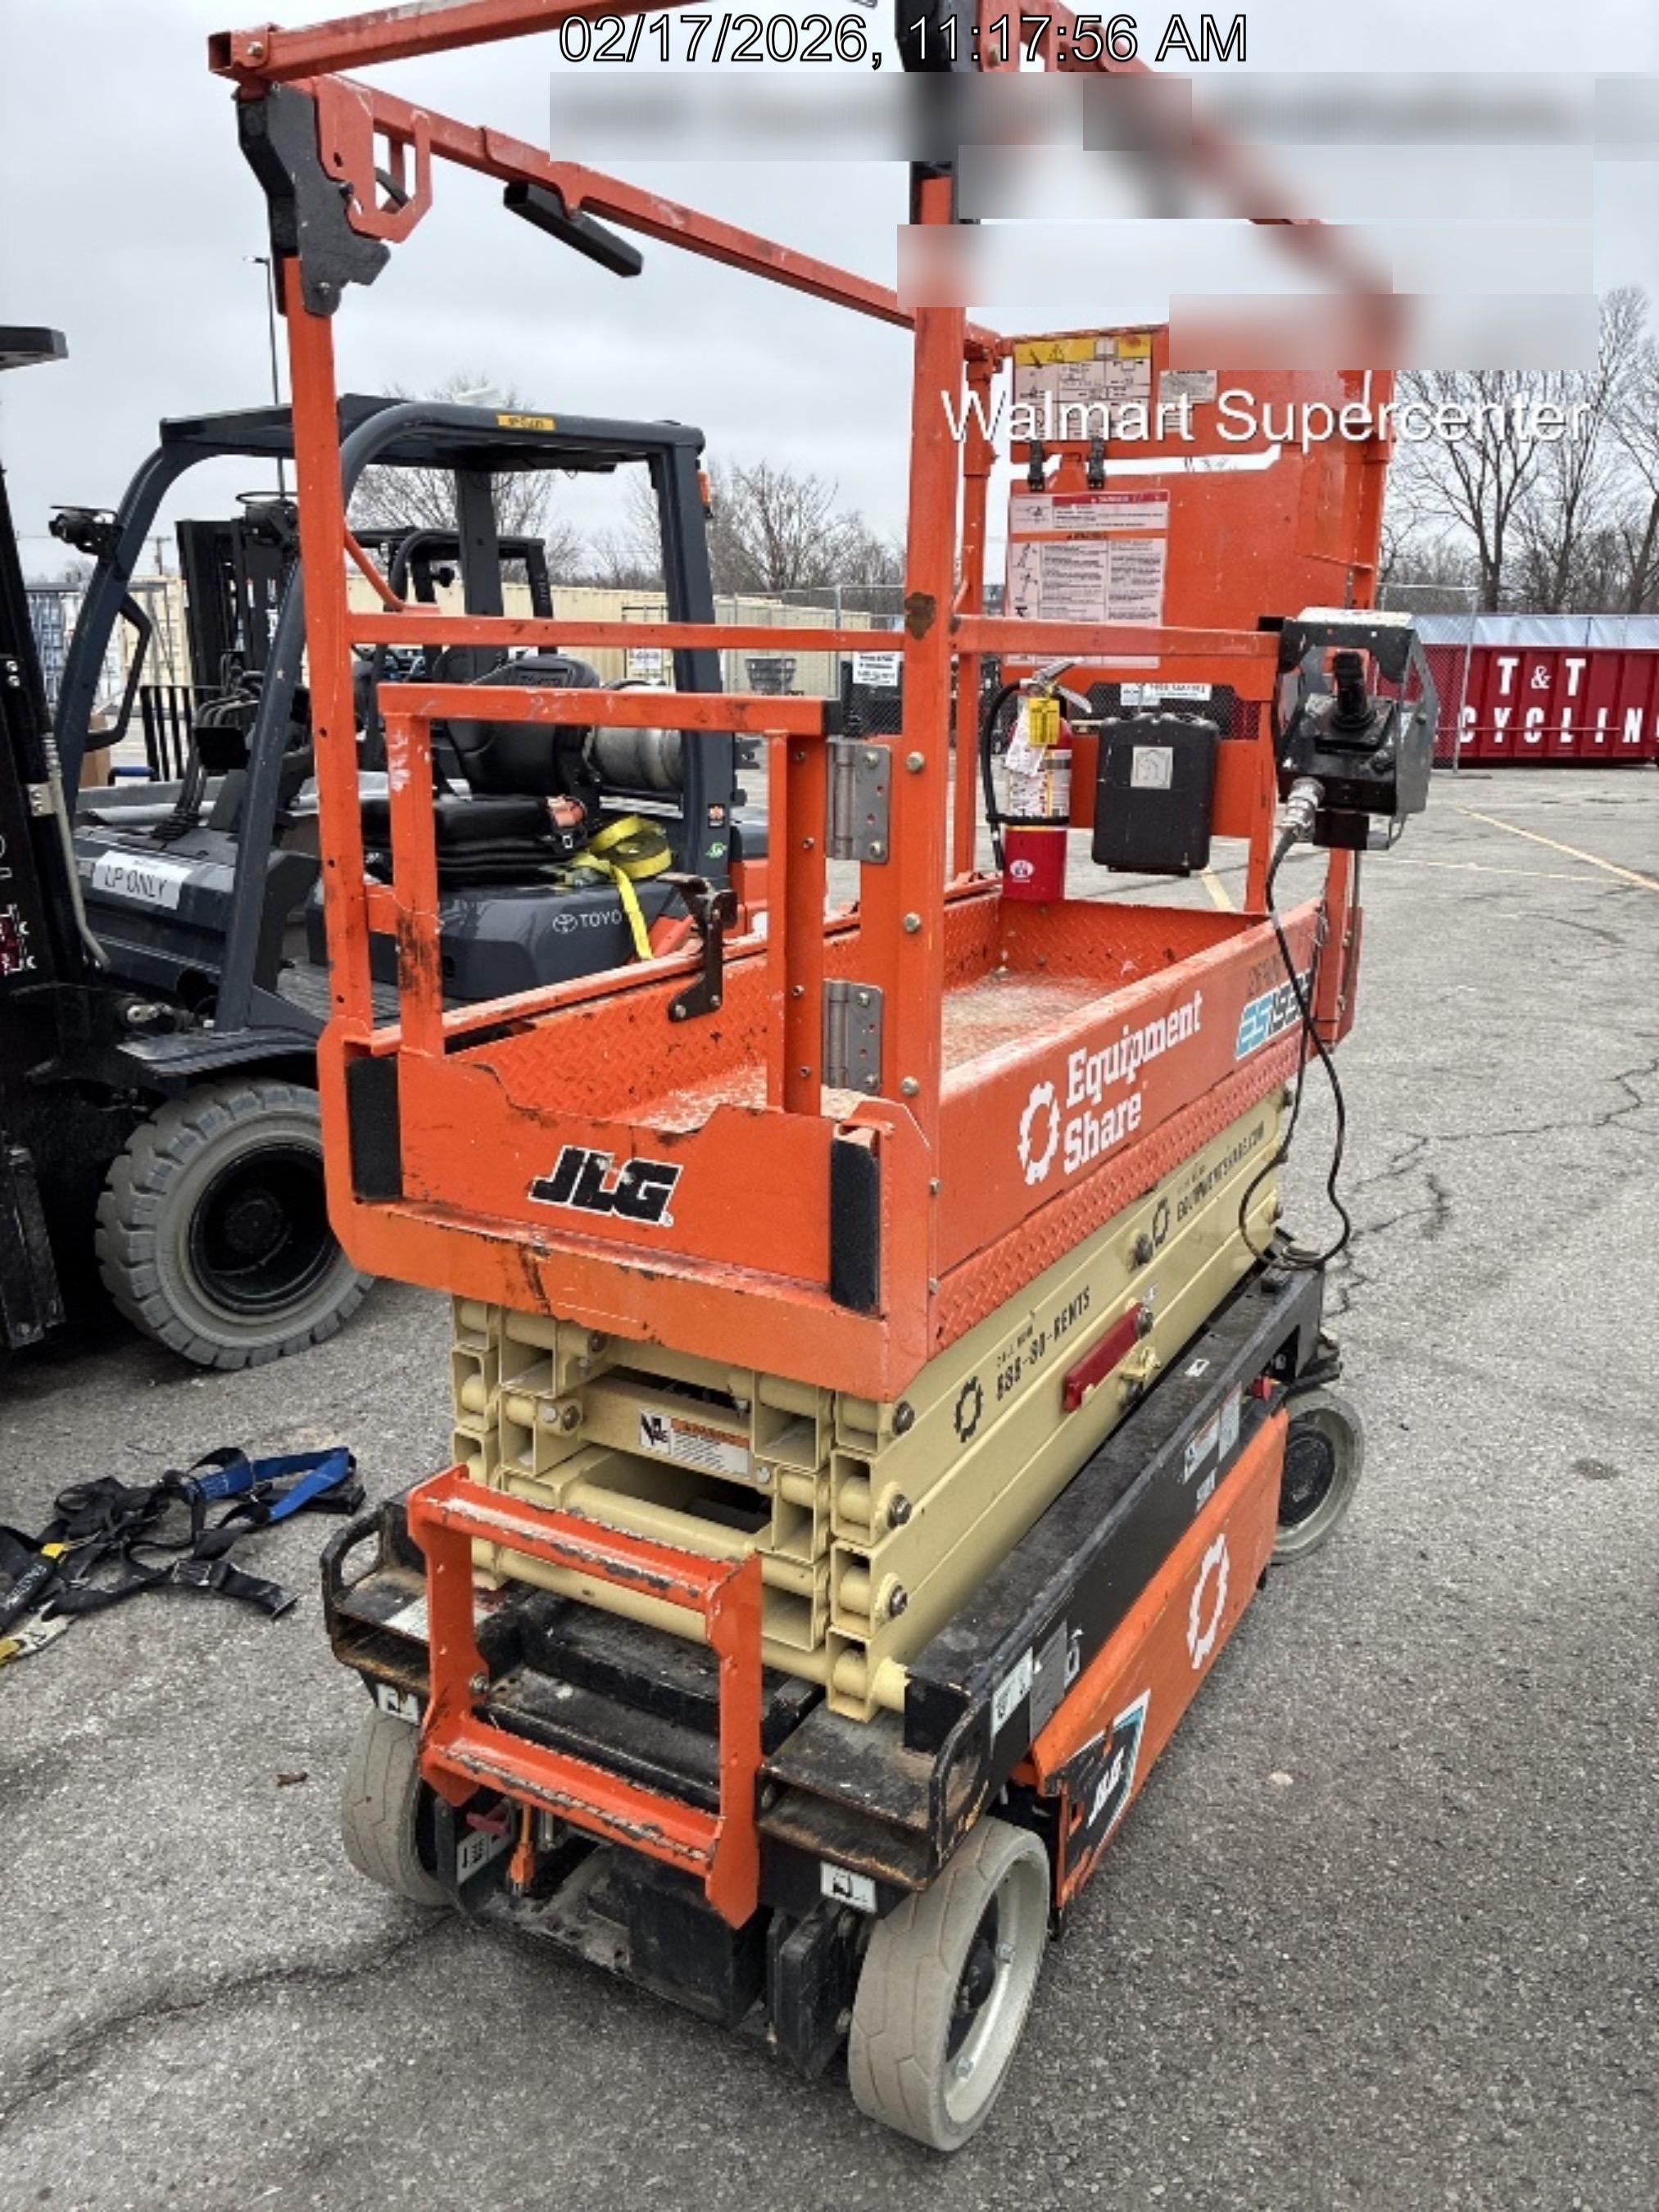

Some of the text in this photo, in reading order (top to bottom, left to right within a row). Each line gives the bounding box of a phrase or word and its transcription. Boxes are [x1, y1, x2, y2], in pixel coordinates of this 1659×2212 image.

[1497, 657, 1587, 696] T & T
[104, 865, 168, 899] LP ONLY
[578, 909, 623, 928] TOYO
[1065, 989, 1203, 1108] Equipment
[1063, 1093, 1142, 1176] Share
[528, 1144, 684, 1227] JLG
